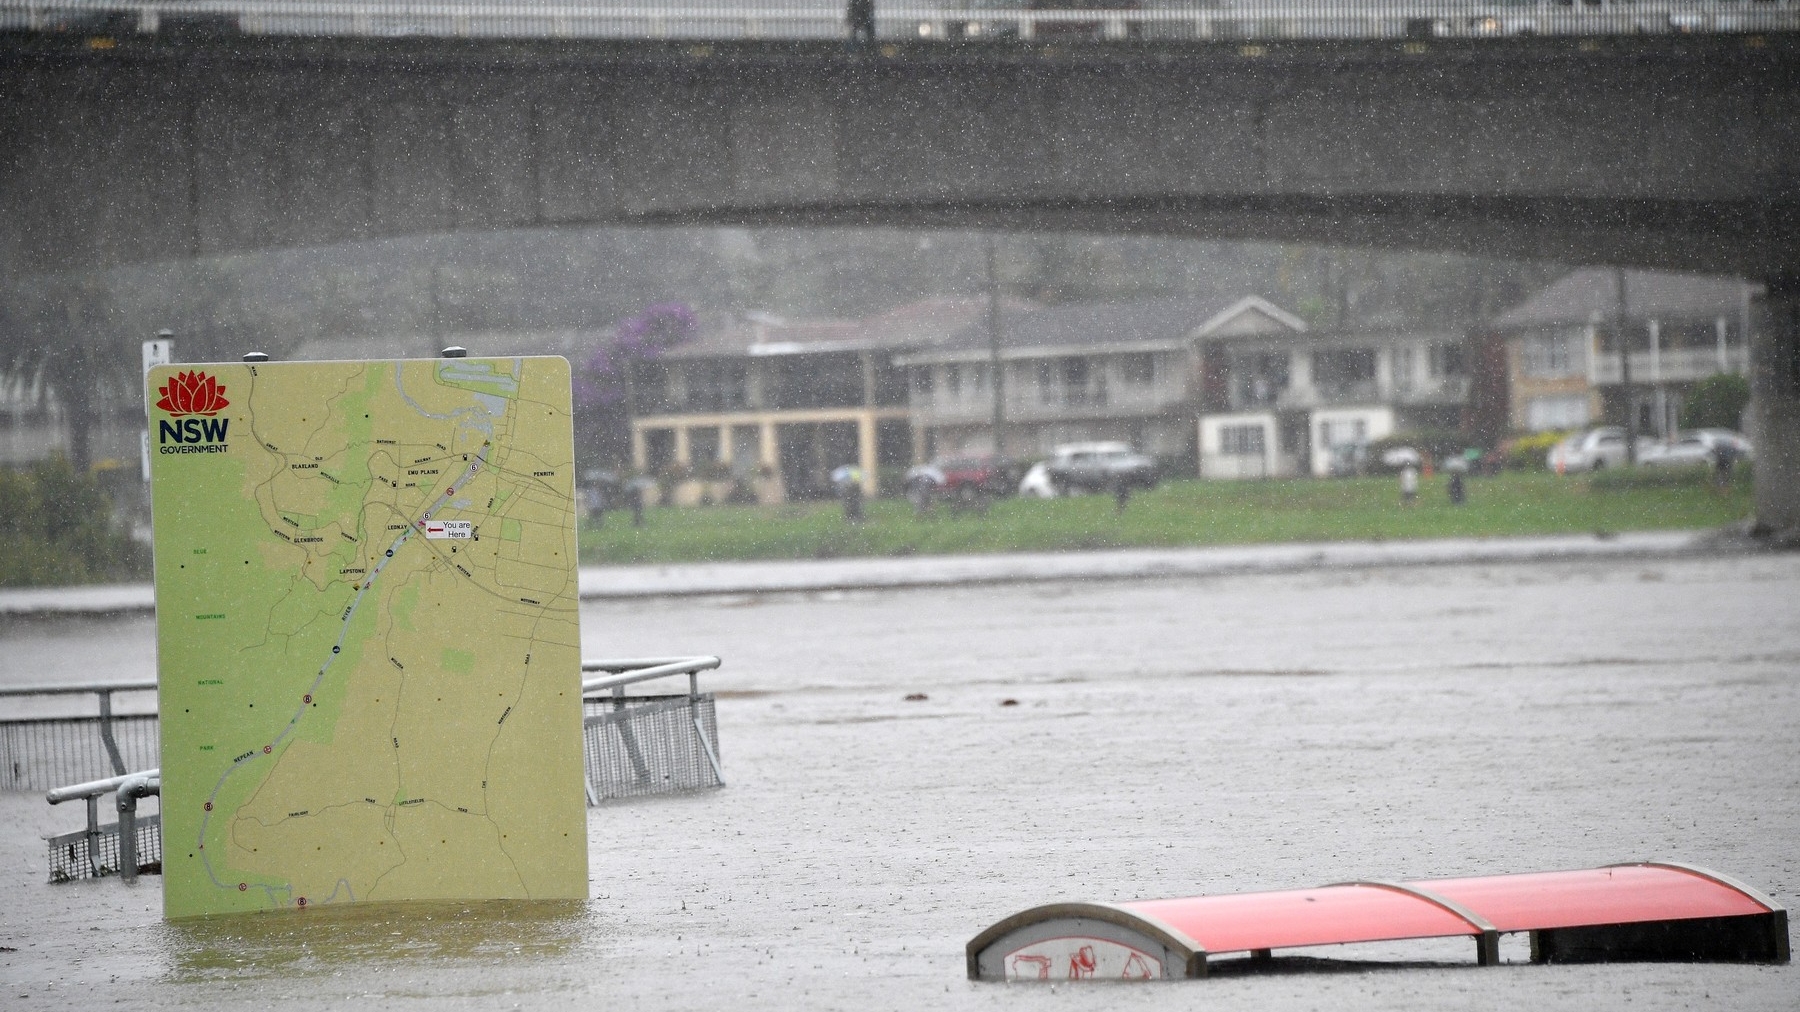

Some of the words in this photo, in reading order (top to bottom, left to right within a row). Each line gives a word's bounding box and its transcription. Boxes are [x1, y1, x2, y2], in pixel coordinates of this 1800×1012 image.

[159, 418, 229, 444] NSW
[160, 445, 228, 454] GOVERNMENT
[266, 443, 278, 451] GREAT
[436, 443, 446, 451] ROAD
[282, 516, 299, 528] WESTERN
[274, 529, 291, 541] WESTERN
[341, 531, 358, 543] HIGHWAY
[456, 564, 472, 578] WESTERN
[341, 606, 352, 622] RIVER
[233, 750, 254, 764] NEPEAN
